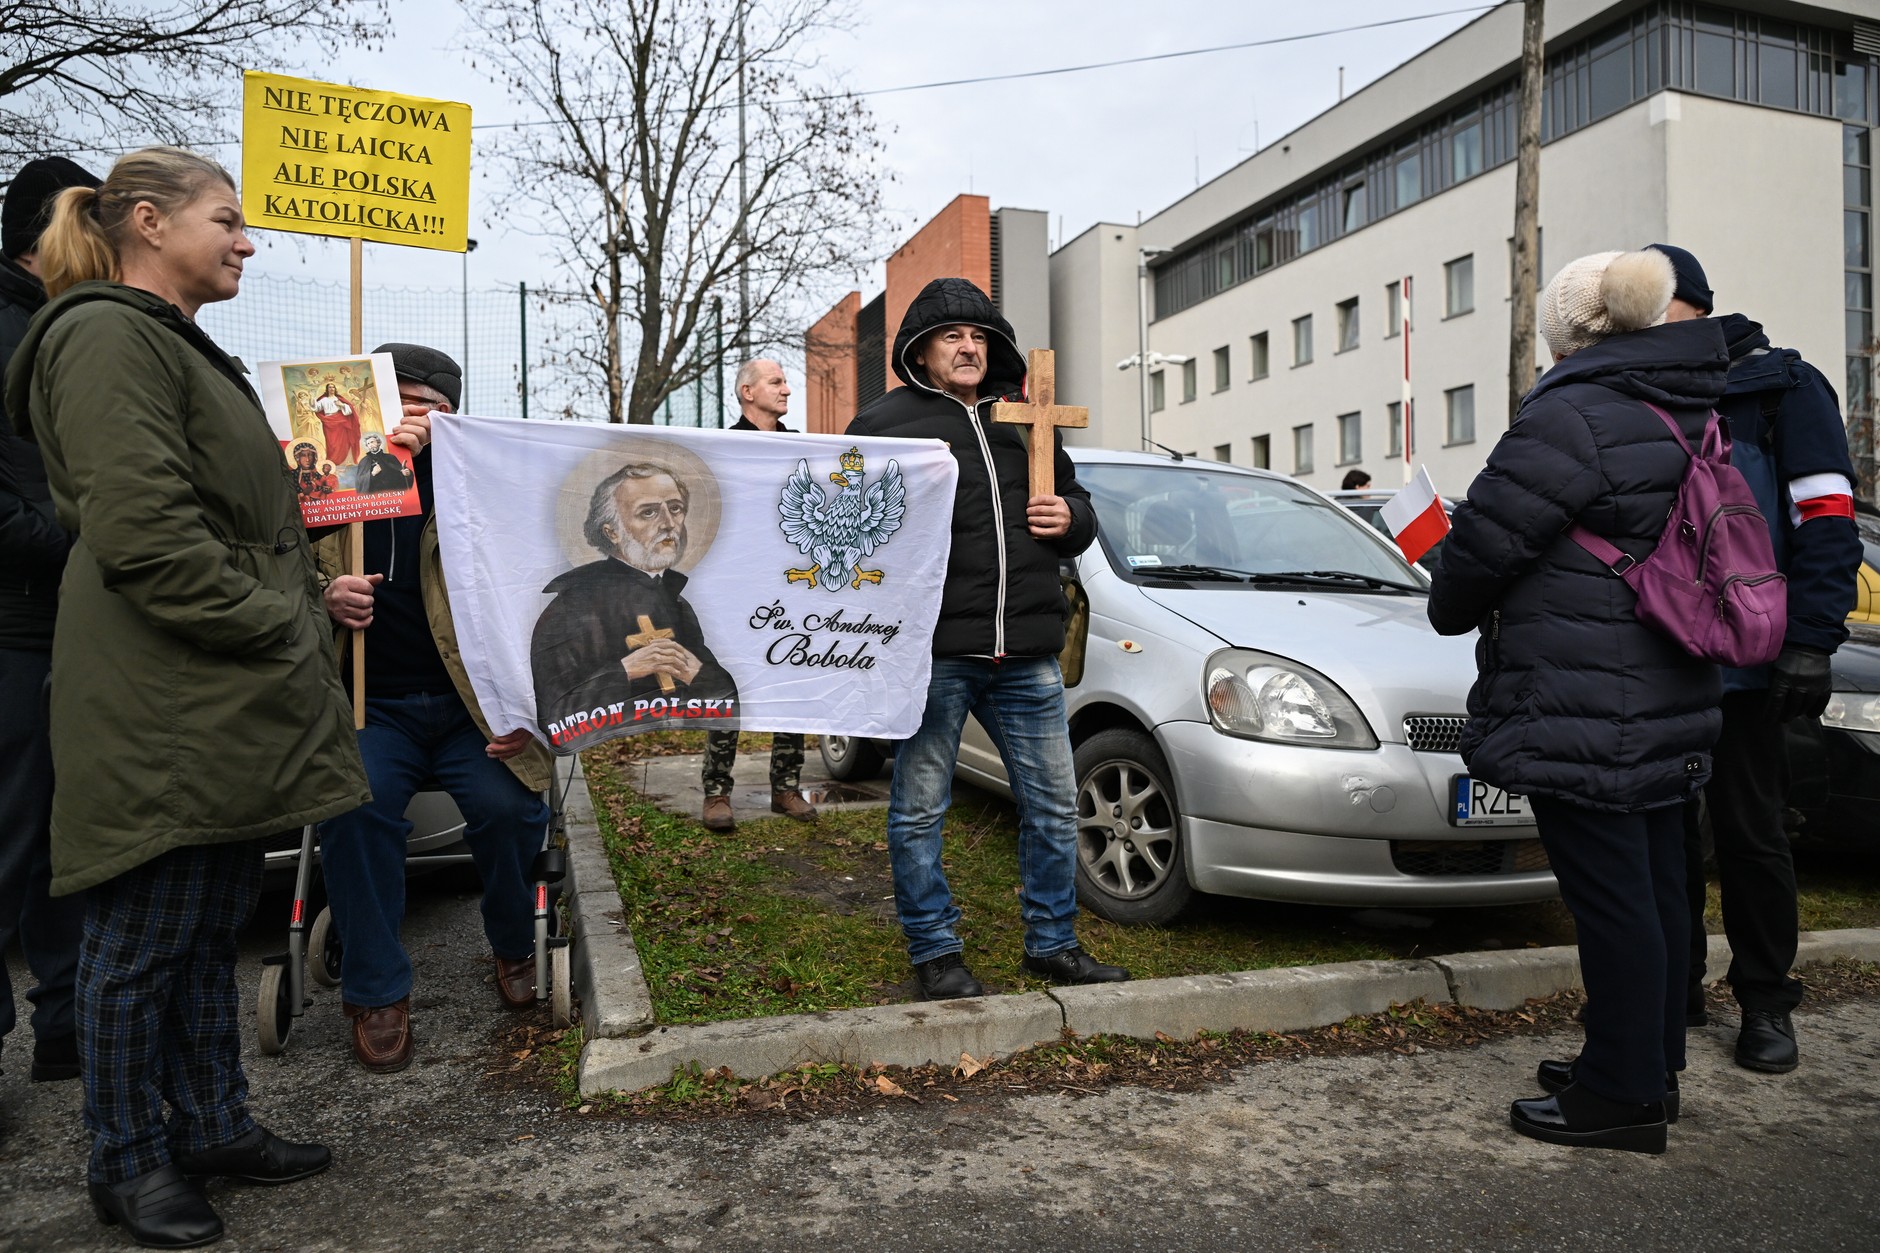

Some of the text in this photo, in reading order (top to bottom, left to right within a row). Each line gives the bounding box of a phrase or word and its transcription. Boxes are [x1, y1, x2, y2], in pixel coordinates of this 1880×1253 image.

[263, 86, 451, 132] NIE TĘCZOWA
[280, 125, 433, 165] NIE LAICKA
[273, 162, 436, 201] ALE POLSKA
[263, 194, 445, 235] KATOLICKA!!!
[306, 506, 402, 523] URATUJEMY POLSKĘ
[324, 501, 369, 513] ANDRZEJEM
[336, 494, 376, 504] KRÓLOWĄ
[377, 490, 405, 499] POLSKI
[749, 599, 902, 645] Św. Andrzej
[765, 633, 876, 670] Bobola
[548, 697, 735, 747] PATRON POLSKI
[1457, 803, 1467, 812] PL
[1472, 781, 1521, 815] RZE
